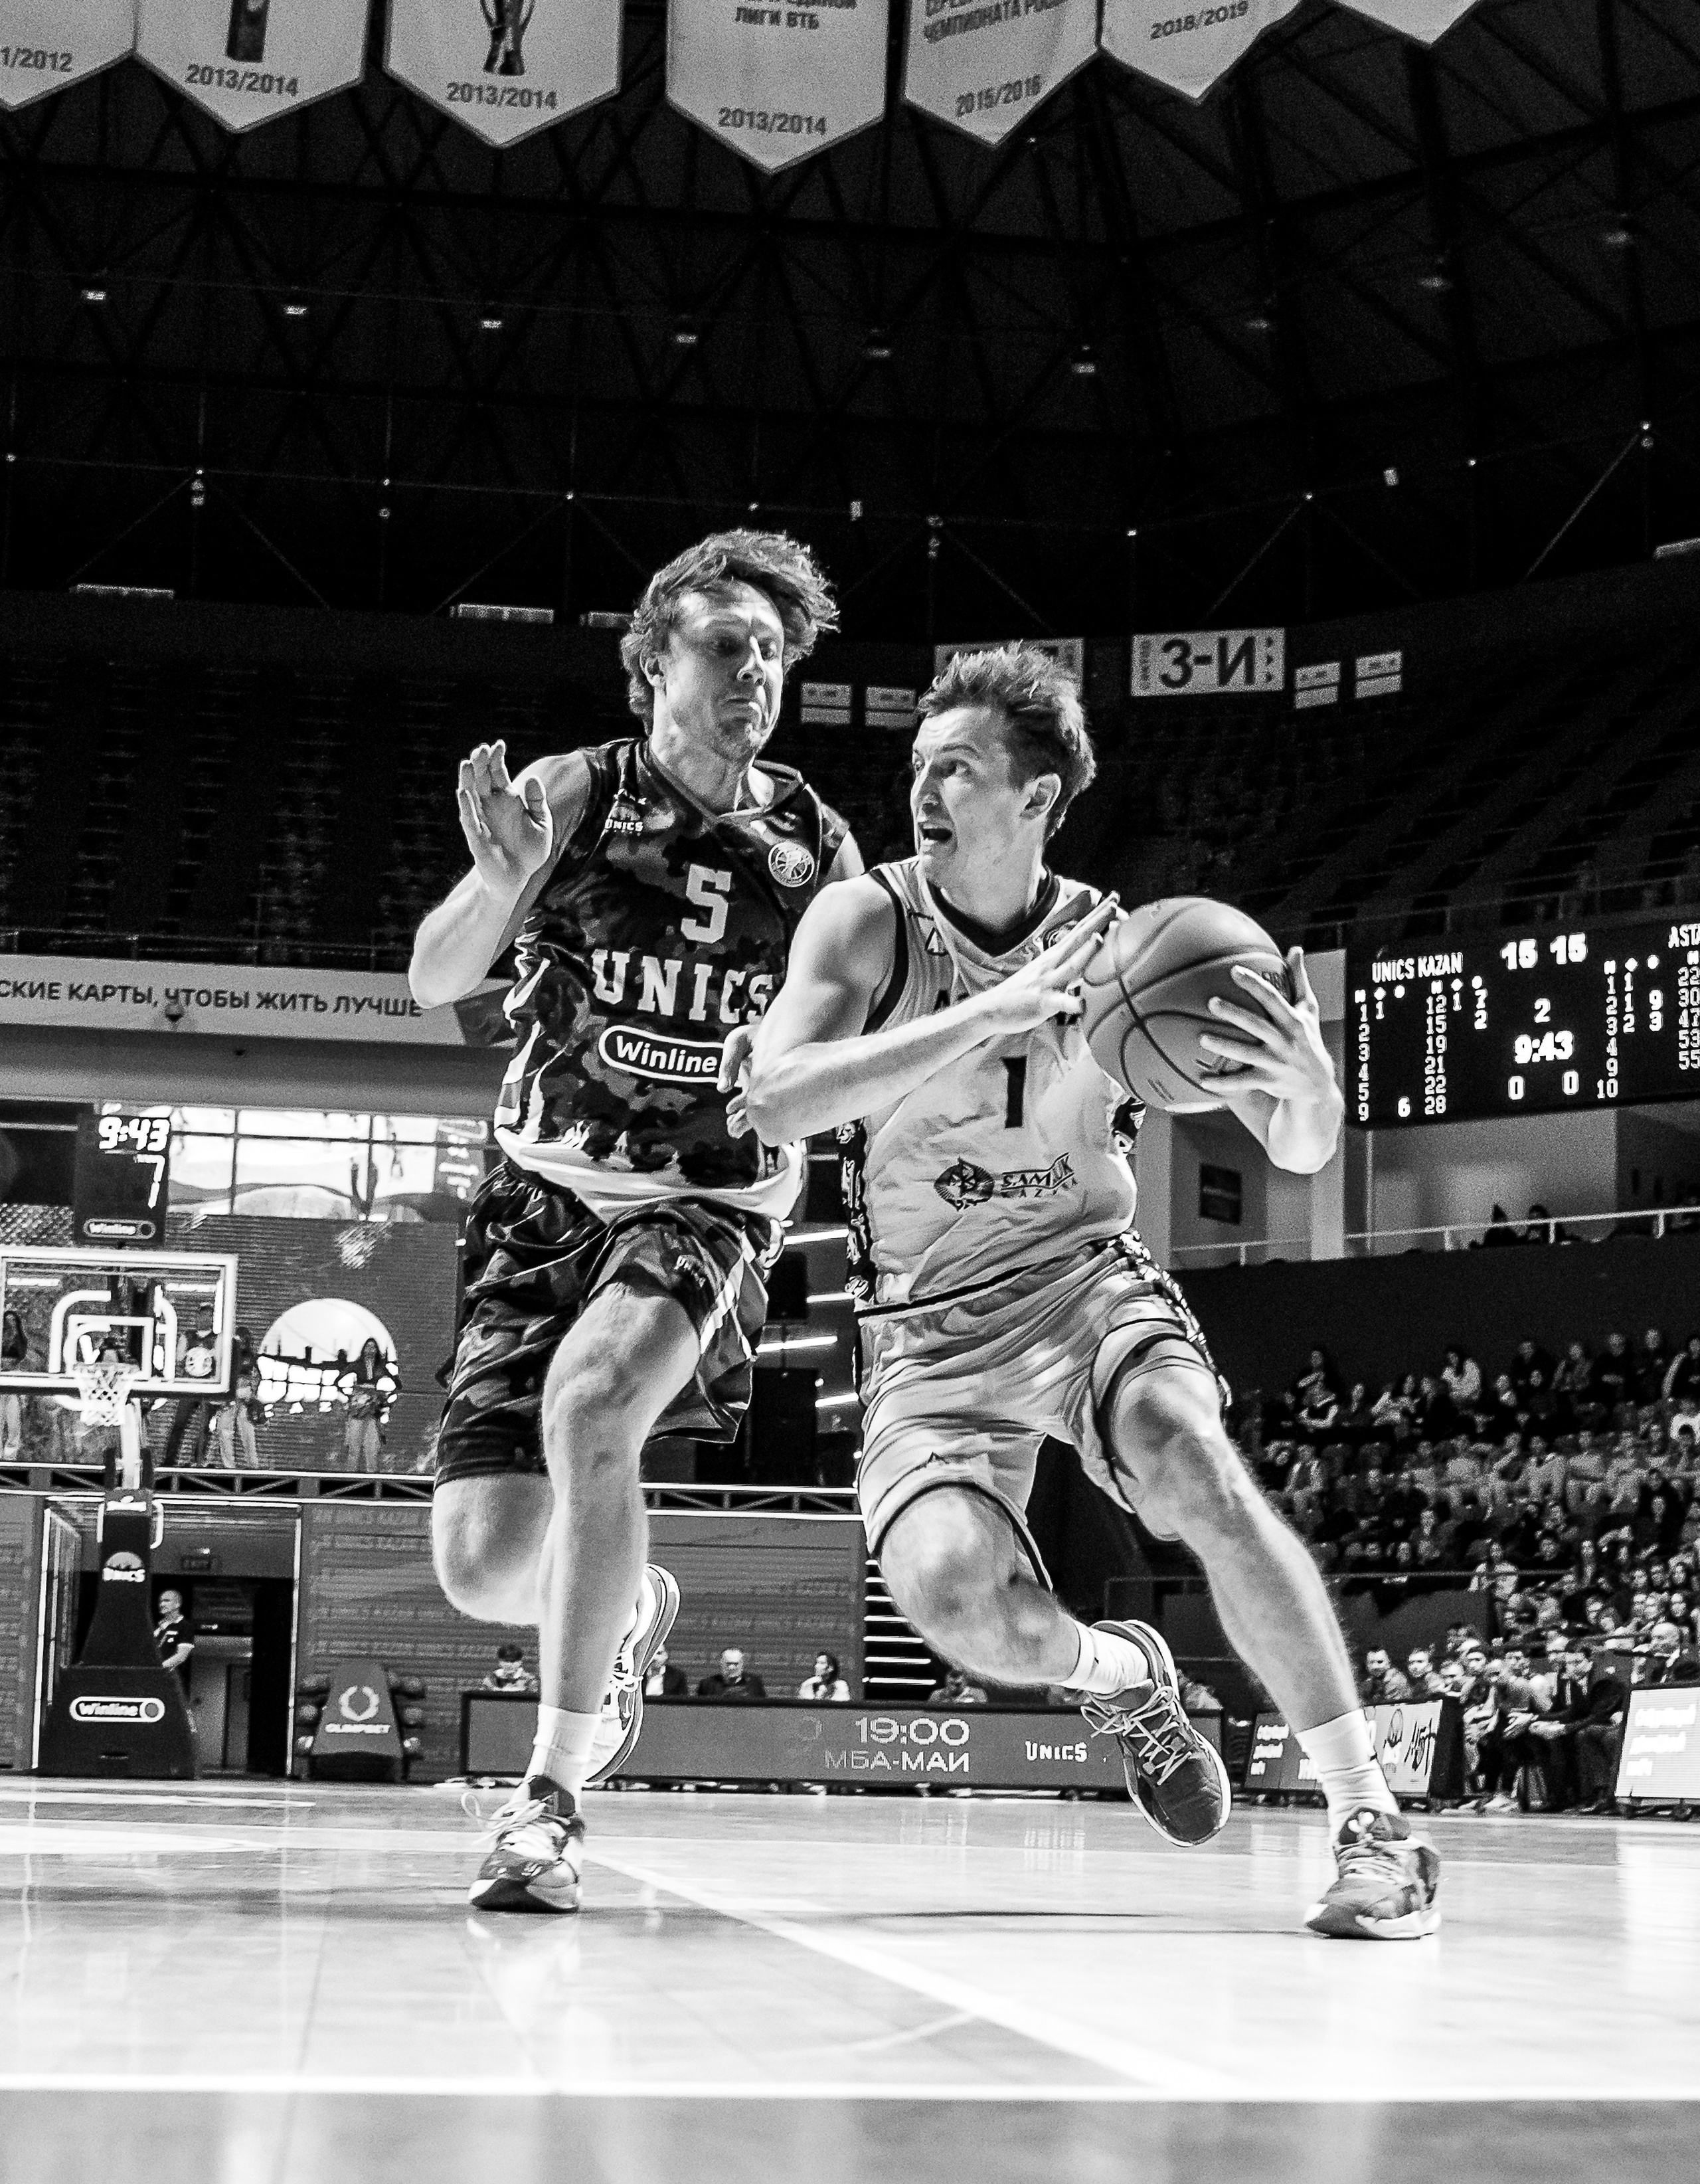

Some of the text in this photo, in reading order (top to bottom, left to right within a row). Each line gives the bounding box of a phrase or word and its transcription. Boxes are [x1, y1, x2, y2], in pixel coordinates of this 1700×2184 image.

[735, 7, 819, 29] ЛИГИ ВТБ
[1149, 0, 1249, 39] 2018/2019
[0, 46, 72, 72] 1/2012
[185, 64, 299, 96] 2013/2014
[446, 82, 557, 110] 2013/2014
[956, 74, 1041, 117] 2015/2016
[718, 107, 827, 136] 2013/2014
[604, 818, 643, 832] UNICS
[681, 864, 732, 944] 5
[1501, 939, 1537, 970] 15
[1550, 933, 1586, 964] 15
[1373, 952, 1462, 982] UNICS KAZAN
[1678, 966, 1700, 986] 22
[591, 949, 773, 1024] UNICS
[1608, 972, 1633, 994] 1 1
[0, 980, 422, 1018] СКИЕ КАРТЫ, ЧТОБЫ ЖИТЬ ЛУЧШЕ
[1427, 992, 1462, 1014] 12 1
[1606, 990, 1663, 1014] 2 1 9
[1679, 986, 1700, 1007] 30
[1361, 1001, 1384, 1022] 1 1
[1475, 1010, 1487, 1029] 2
[1535, 998, 1550, 1023] 2
[1359, 1023, 1369, 1042] 2
[1427, 1015, 1446, 1034] 15
[1607, 1011, 1661, 1036] 3 2 3
[1427, 1035, 1446, 1054] 19
[1515, 1031, 1573, 1063] 9:43
[1679, 1028, 1700, 1048] 53
[616, 1035, 717, 1073] Winline
[1359, 1044, 1369, 1061] 3
[1679, 1049, 1700, 1069] 55
[1359, 1063, 1368, 1081] 4
[1425, 1055, 1444, 1074] 21
[1606, 1058, 1618, 1077] 9
[999, 1056, 1027, 1128] 1
[1359, 1083, 1369, 1101] 5
[1425, 1075, 1446, 1095] 22
[1509, 1071, 1578, 1099] 0 0
[1598, 1079, 1618, 1098] 10
[1359, 1103, 1369, 1121] 9
[1399, 1097, 1410, 1117] 6
[1425, 1095, 1446, 1115] 28
[99, 1117, 171, 1152] 9:43
[133, 1154, 166, 1210] 7
[855, 1717, 970, 1746] 19:00
[825, 1748, 970, 1773] МБА-МАИ
[1025, 1740, 1088, 1762] UNICS
